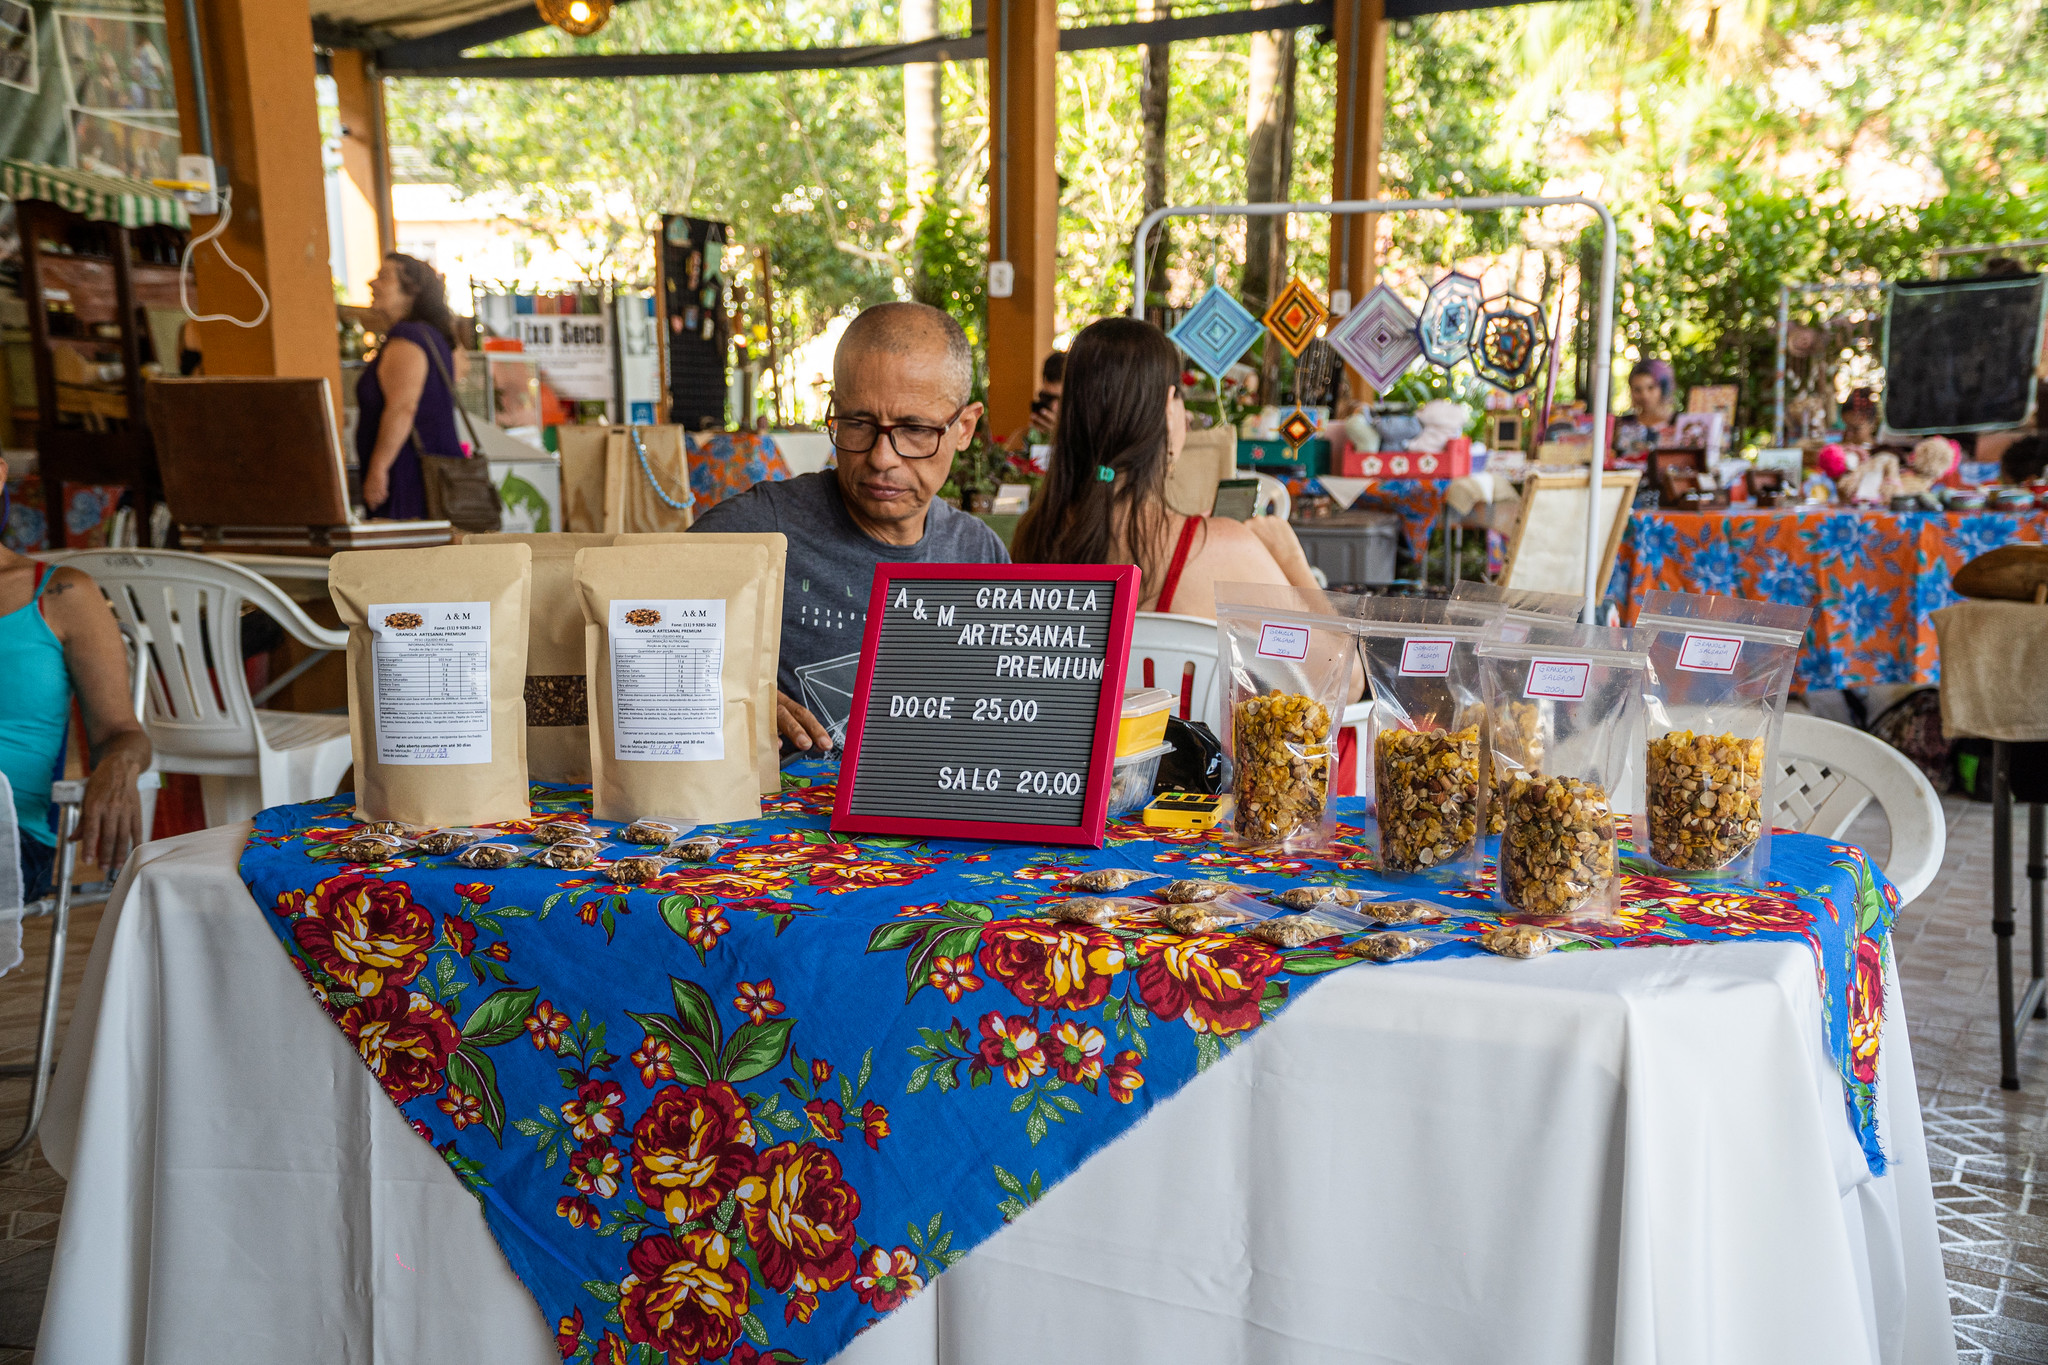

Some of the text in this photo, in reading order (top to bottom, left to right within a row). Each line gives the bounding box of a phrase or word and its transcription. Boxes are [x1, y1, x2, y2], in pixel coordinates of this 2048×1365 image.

[561, 319, 605, 344] Seco
[893, 587, 955, 627] A & M
[976, 587, 1097, 611] GRANOLA
[957, 624, 1091, 648] ARTESANAL
[996, 655, 1106, 680] PREMIUM
[1538, 665, 1574, 673] GRANOLA
[890, 695, 1038, 723] DOCE 25,00
[937, 766, 1081, 796] SALG 20,00
